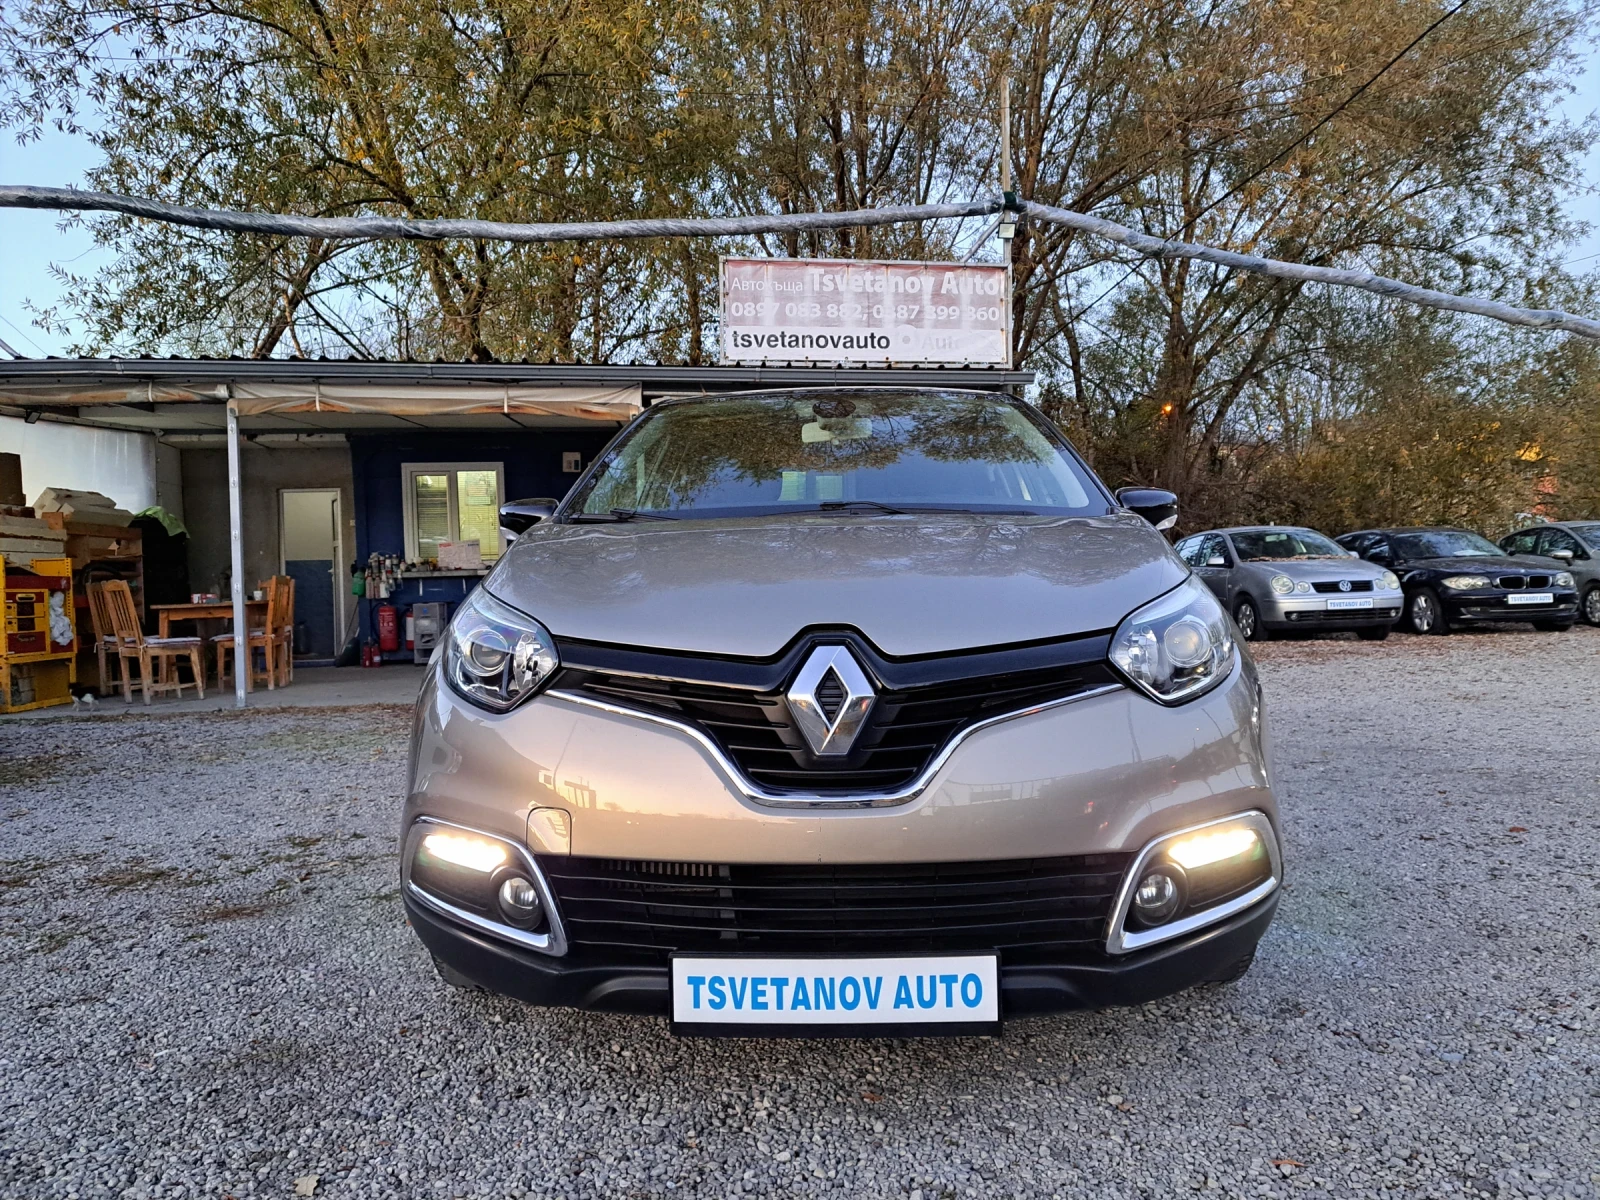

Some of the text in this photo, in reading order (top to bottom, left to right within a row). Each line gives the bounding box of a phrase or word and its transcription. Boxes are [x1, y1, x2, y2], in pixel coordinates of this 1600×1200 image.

[808, 269, 1000, 296] Tsvetanov Auto
[731, 301, 780, 317] 0897
[785, 302, 821, 318] 083
[826, 303, 868, 321] 882,
[732, 330, 891, 349] tsvetanovauto
[687, 973, 983, 1011] TSVETANOV AUTO
